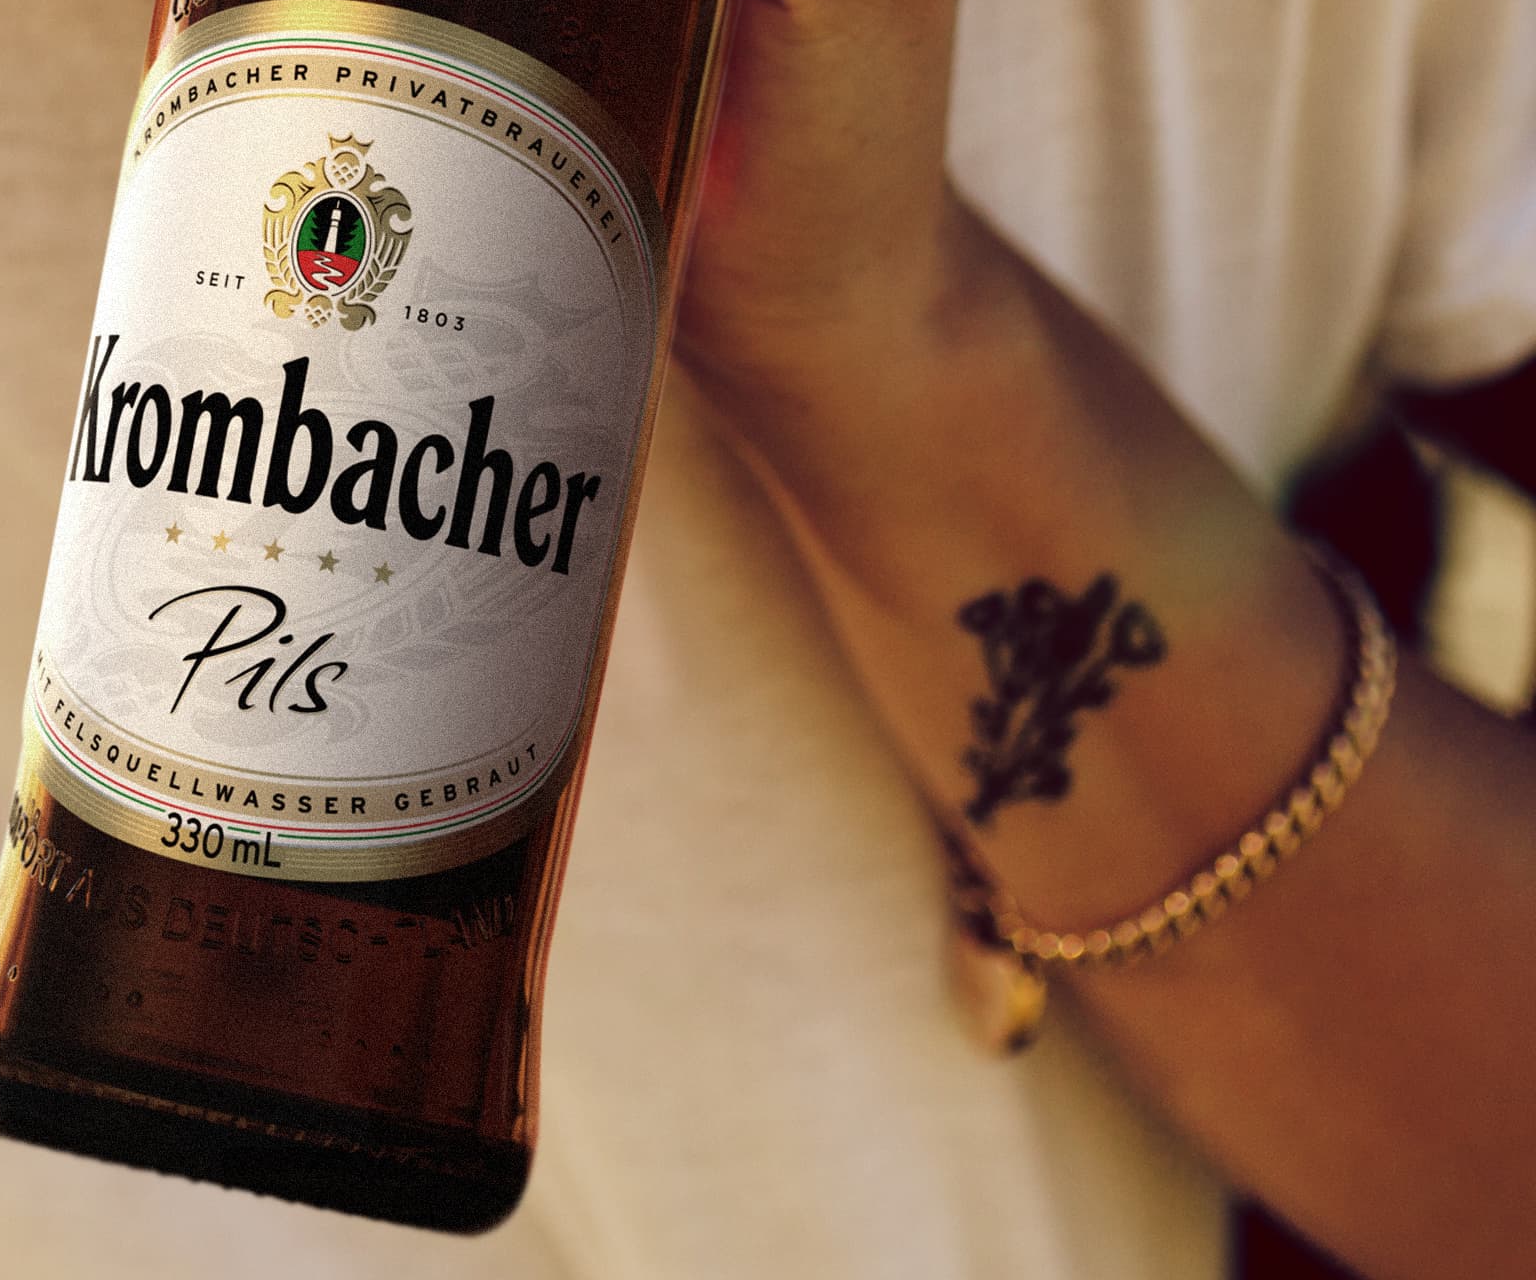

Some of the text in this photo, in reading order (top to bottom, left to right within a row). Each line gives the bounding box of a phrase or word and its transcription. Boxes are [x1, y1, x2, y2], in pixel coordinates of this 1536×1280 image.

[335, 66, 623, 245] PRIVATBRAUEREI
[195, 270, 465, 331] SEIT 1803
[68, 334, 601, 576] Krombacher
[148, 585, 348, 714] Pils
[54, 699, 366, 815] FELSQUELLWASSER
[394, 743, 536, 811] GEBRAUT
[160, 812, 282, 869] 330 mL
